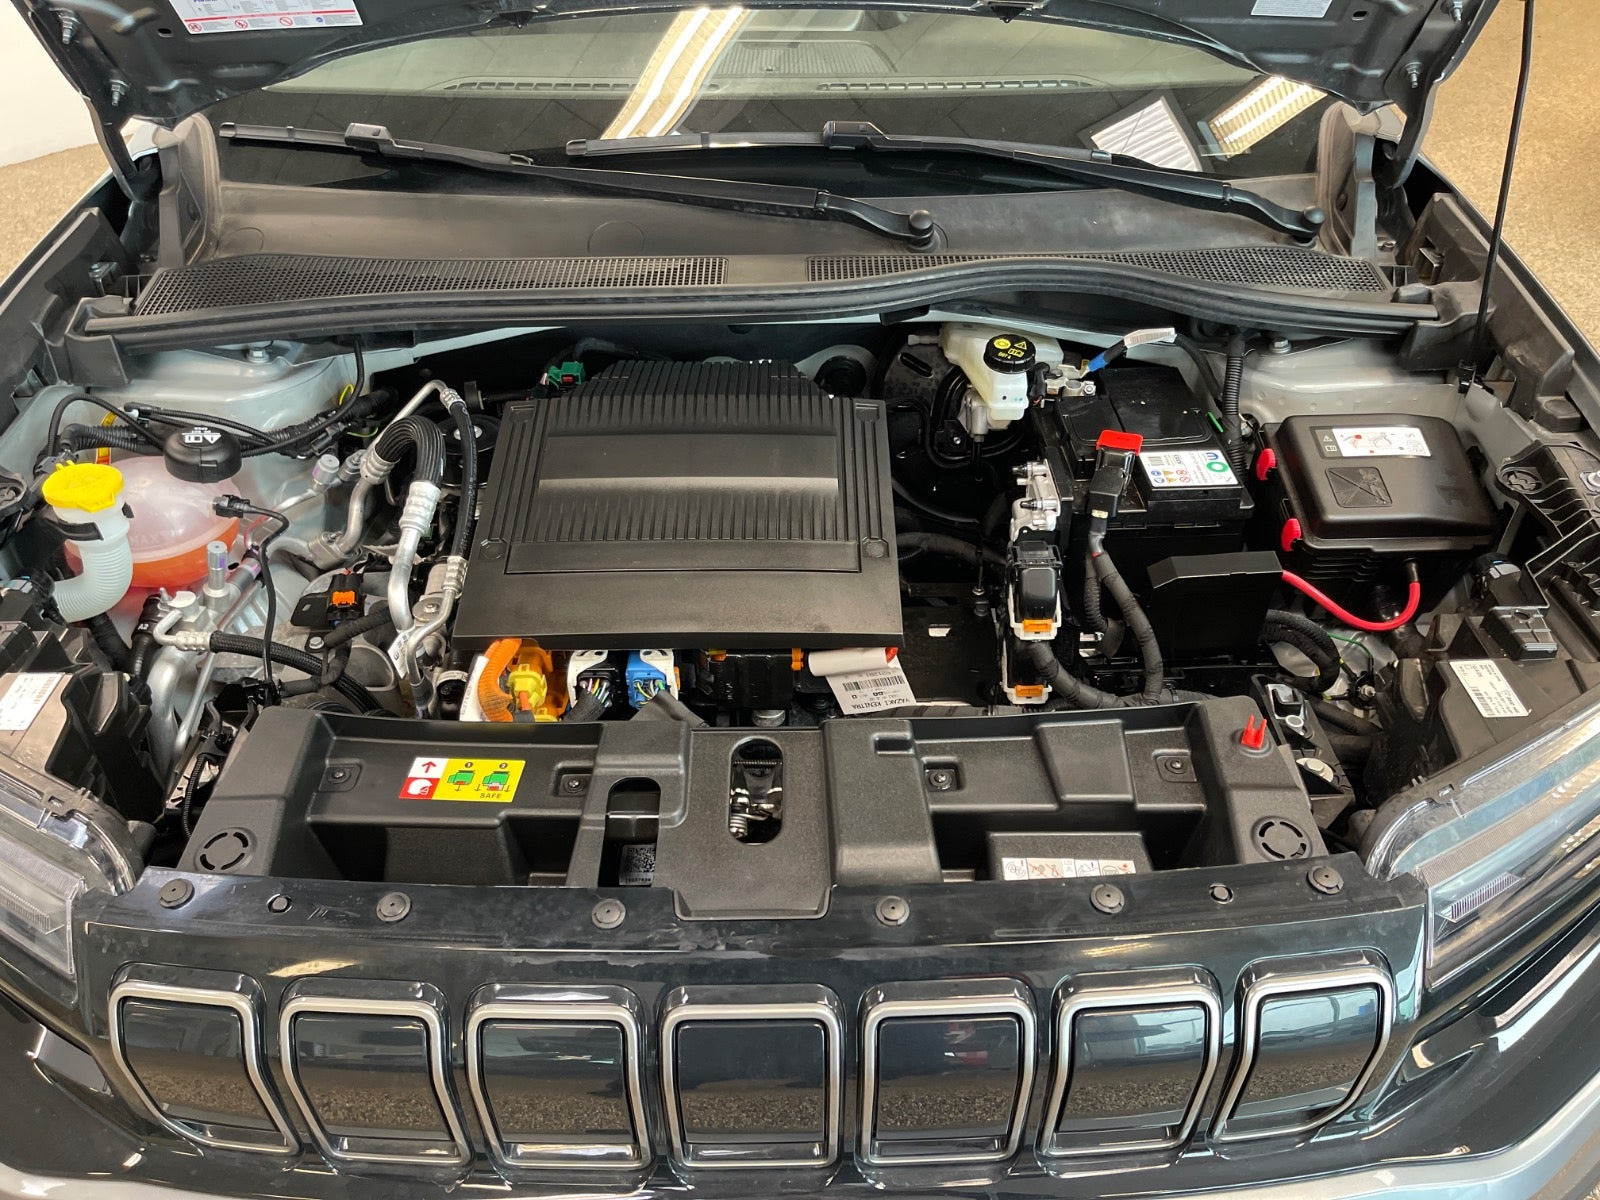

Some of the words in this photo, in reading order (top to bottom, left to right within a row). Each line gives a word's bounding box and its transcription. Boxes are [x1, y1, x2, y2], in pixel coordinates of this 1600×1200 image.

[138, 623, 149, 631] A2
[851, 701, 882, 710] KENITRA
[885, 697, 911, 706] YAZAKI
